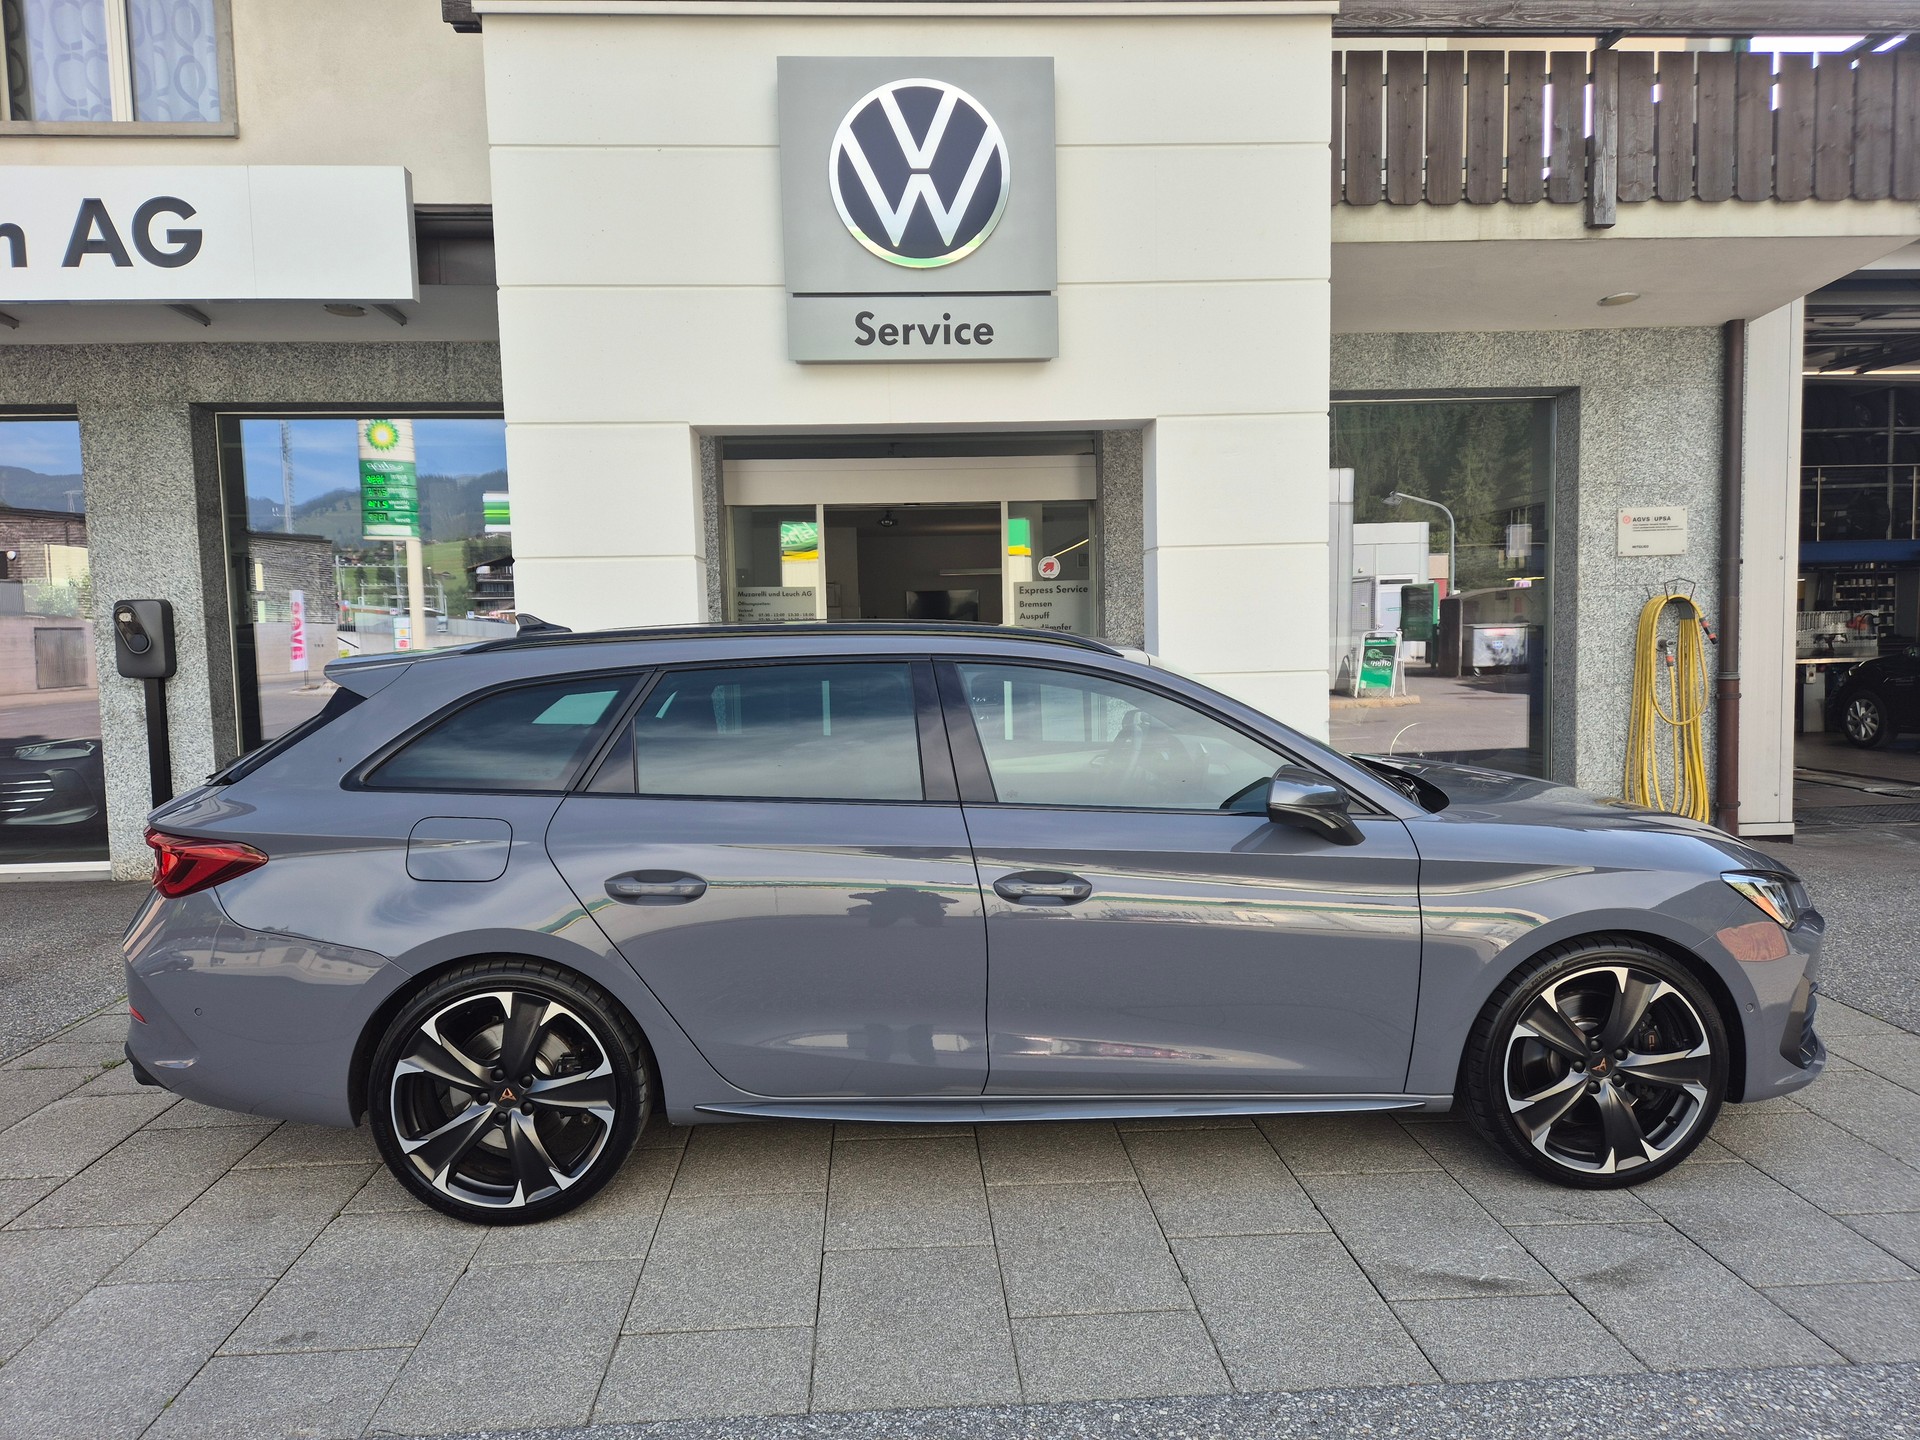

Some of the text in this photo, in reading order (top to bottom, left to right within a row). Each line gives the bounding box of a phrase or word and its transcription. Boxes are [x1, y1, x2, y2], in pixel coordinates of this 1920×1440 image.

[61, 195, 203, 269] AG
[854, 310, 994, 346] Service
[1019, 585, 1088, 596] Express Service
[1019, 600, 1053, 608] Bremsen
[1019, 611, 1050, 621] Auspuff
